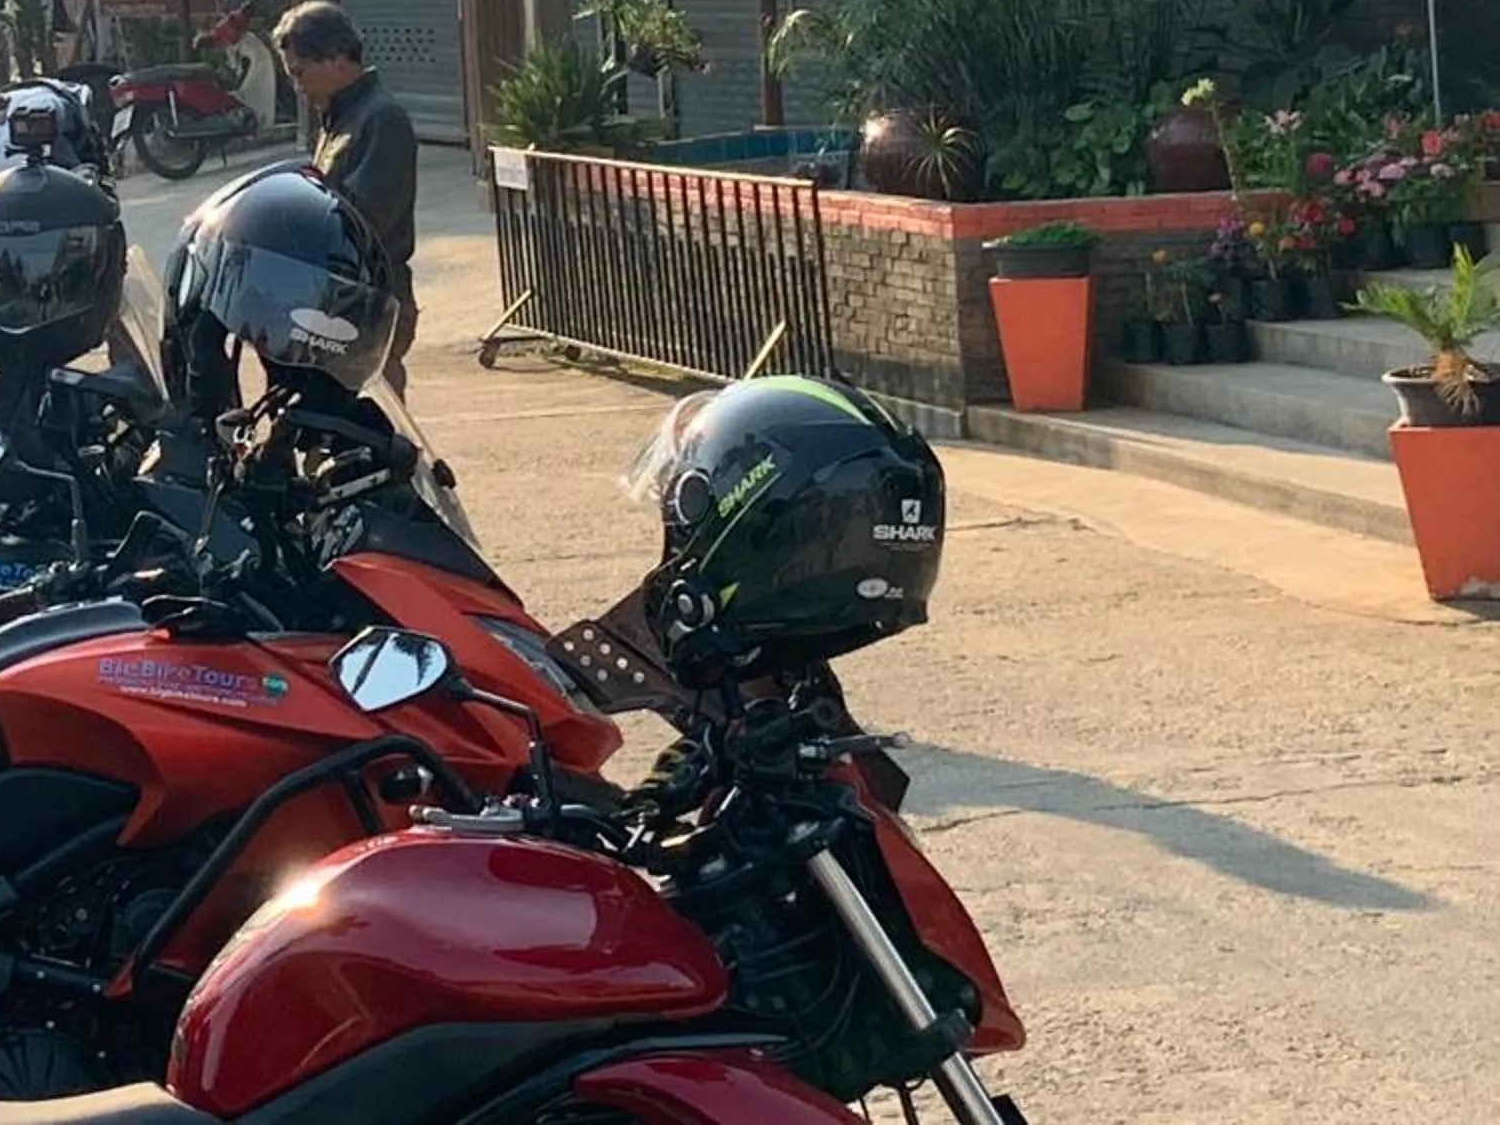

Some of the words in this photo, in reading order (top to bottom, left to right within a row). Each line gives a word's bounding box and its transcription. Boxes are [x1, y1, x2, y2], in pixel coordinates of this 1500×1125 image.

[291, 327, 348, 355] SHARK
[717, 453, 776, 518] SHARK
[873, 525, 935, 541] SHARK
